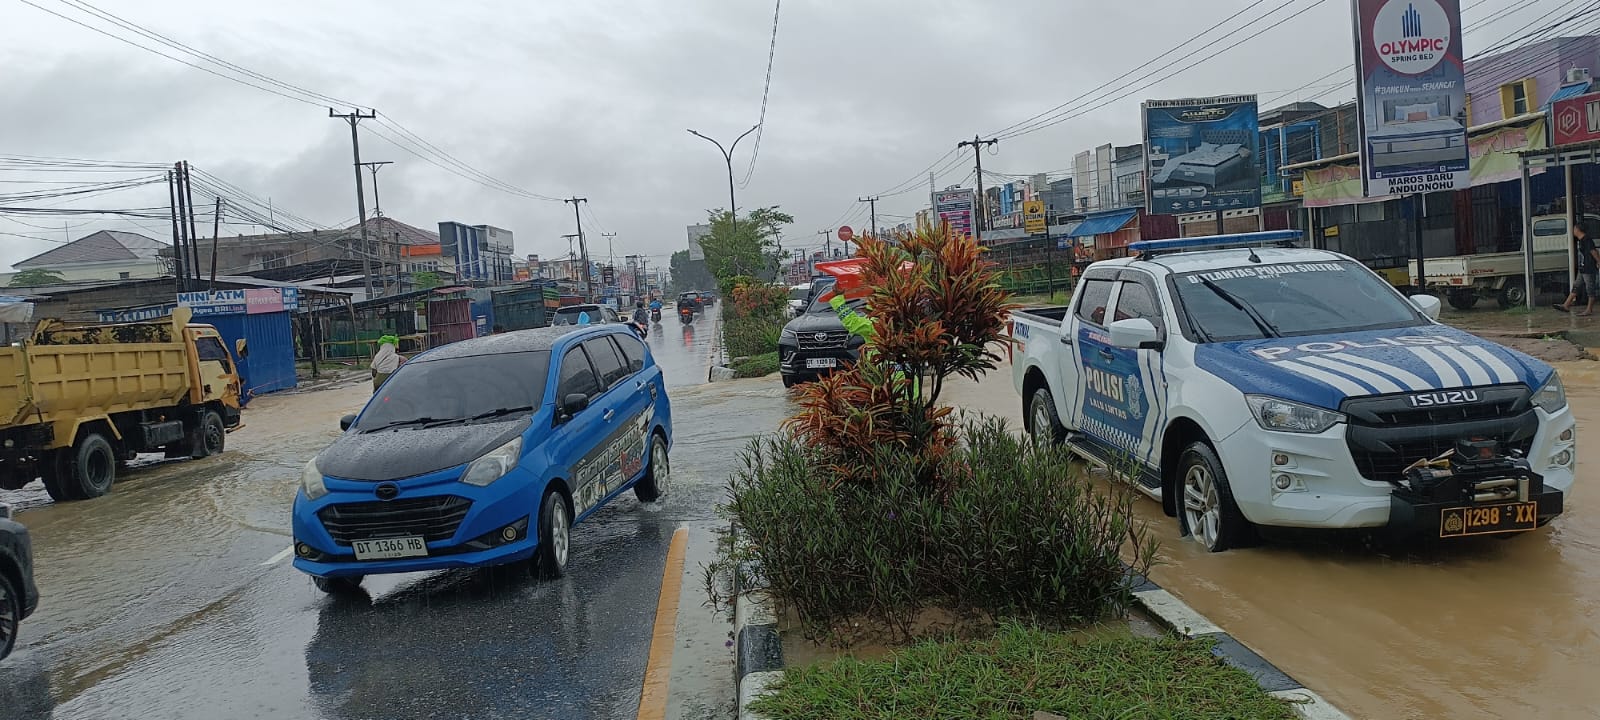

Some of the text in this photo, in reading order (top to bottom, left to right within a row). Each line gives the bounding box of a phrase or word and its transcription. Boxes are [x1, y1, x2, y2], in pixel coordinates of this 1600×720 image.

[1380, 38, 1444, 55] OLYMPIC
[1391, 53, 1434, 63] SPRING BED
[1388, 173, 1454, 186] MAROS BARU
[1389, 181, 1454, 194] ANDUONOHU
[1253, 264, 1298, 277] POLDA
[1296, 263, 1345, 273] SULTRA
[178, 292, 210, 303] MINI
[214, 290, 245, 301] ATM
[1250, 335, 1461, 361] POLISI
[1085, 366, 1124, 401] POLISI
[1410, 390, 1478, 406] ISUZU
[1105, 403, 1127, 419] LINTAS
[1466, 505, 1535, 527] 1298 XX
[357, 538, 423, 554] DT 1366 HB
